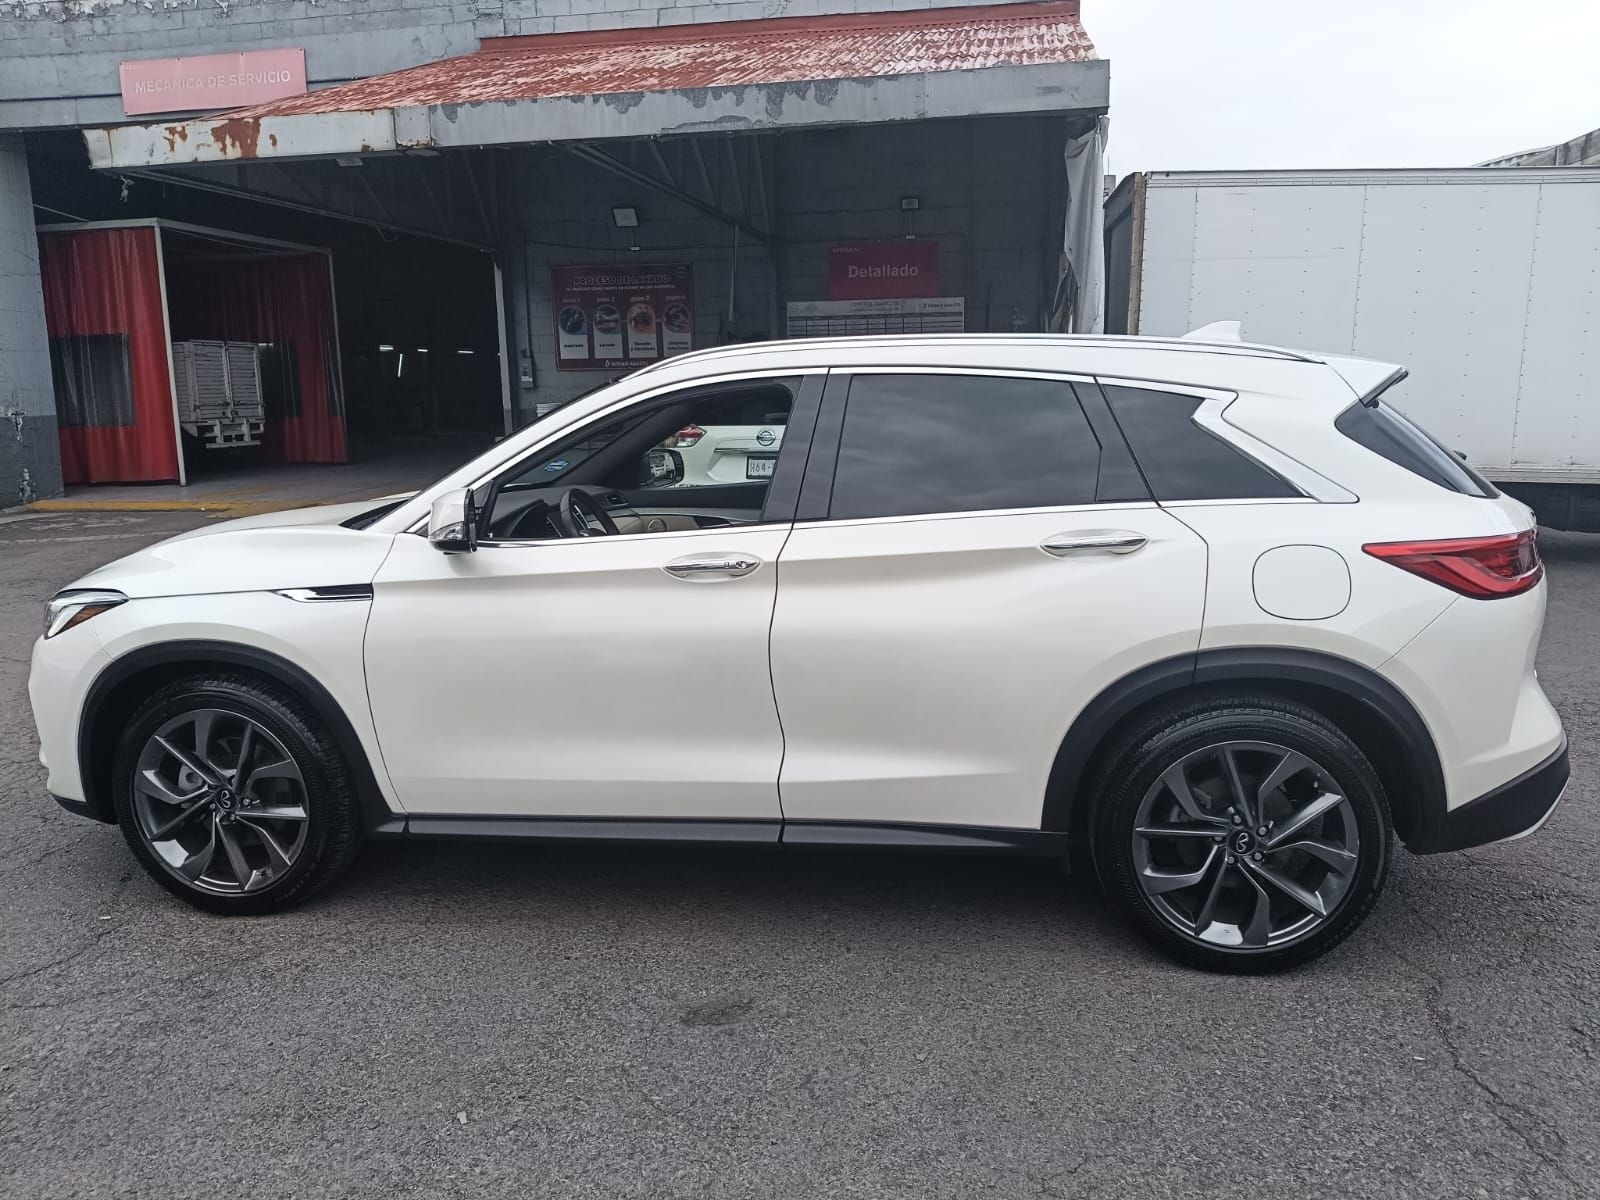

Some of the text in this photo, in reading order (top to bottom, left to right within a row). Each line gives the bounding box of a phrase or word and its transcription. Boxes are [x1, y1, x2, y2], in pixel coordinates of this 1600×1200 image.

[134, 70, 291, 94] MECANICA DE SERVICIO
[848, 264, 919, 279] Detallado
